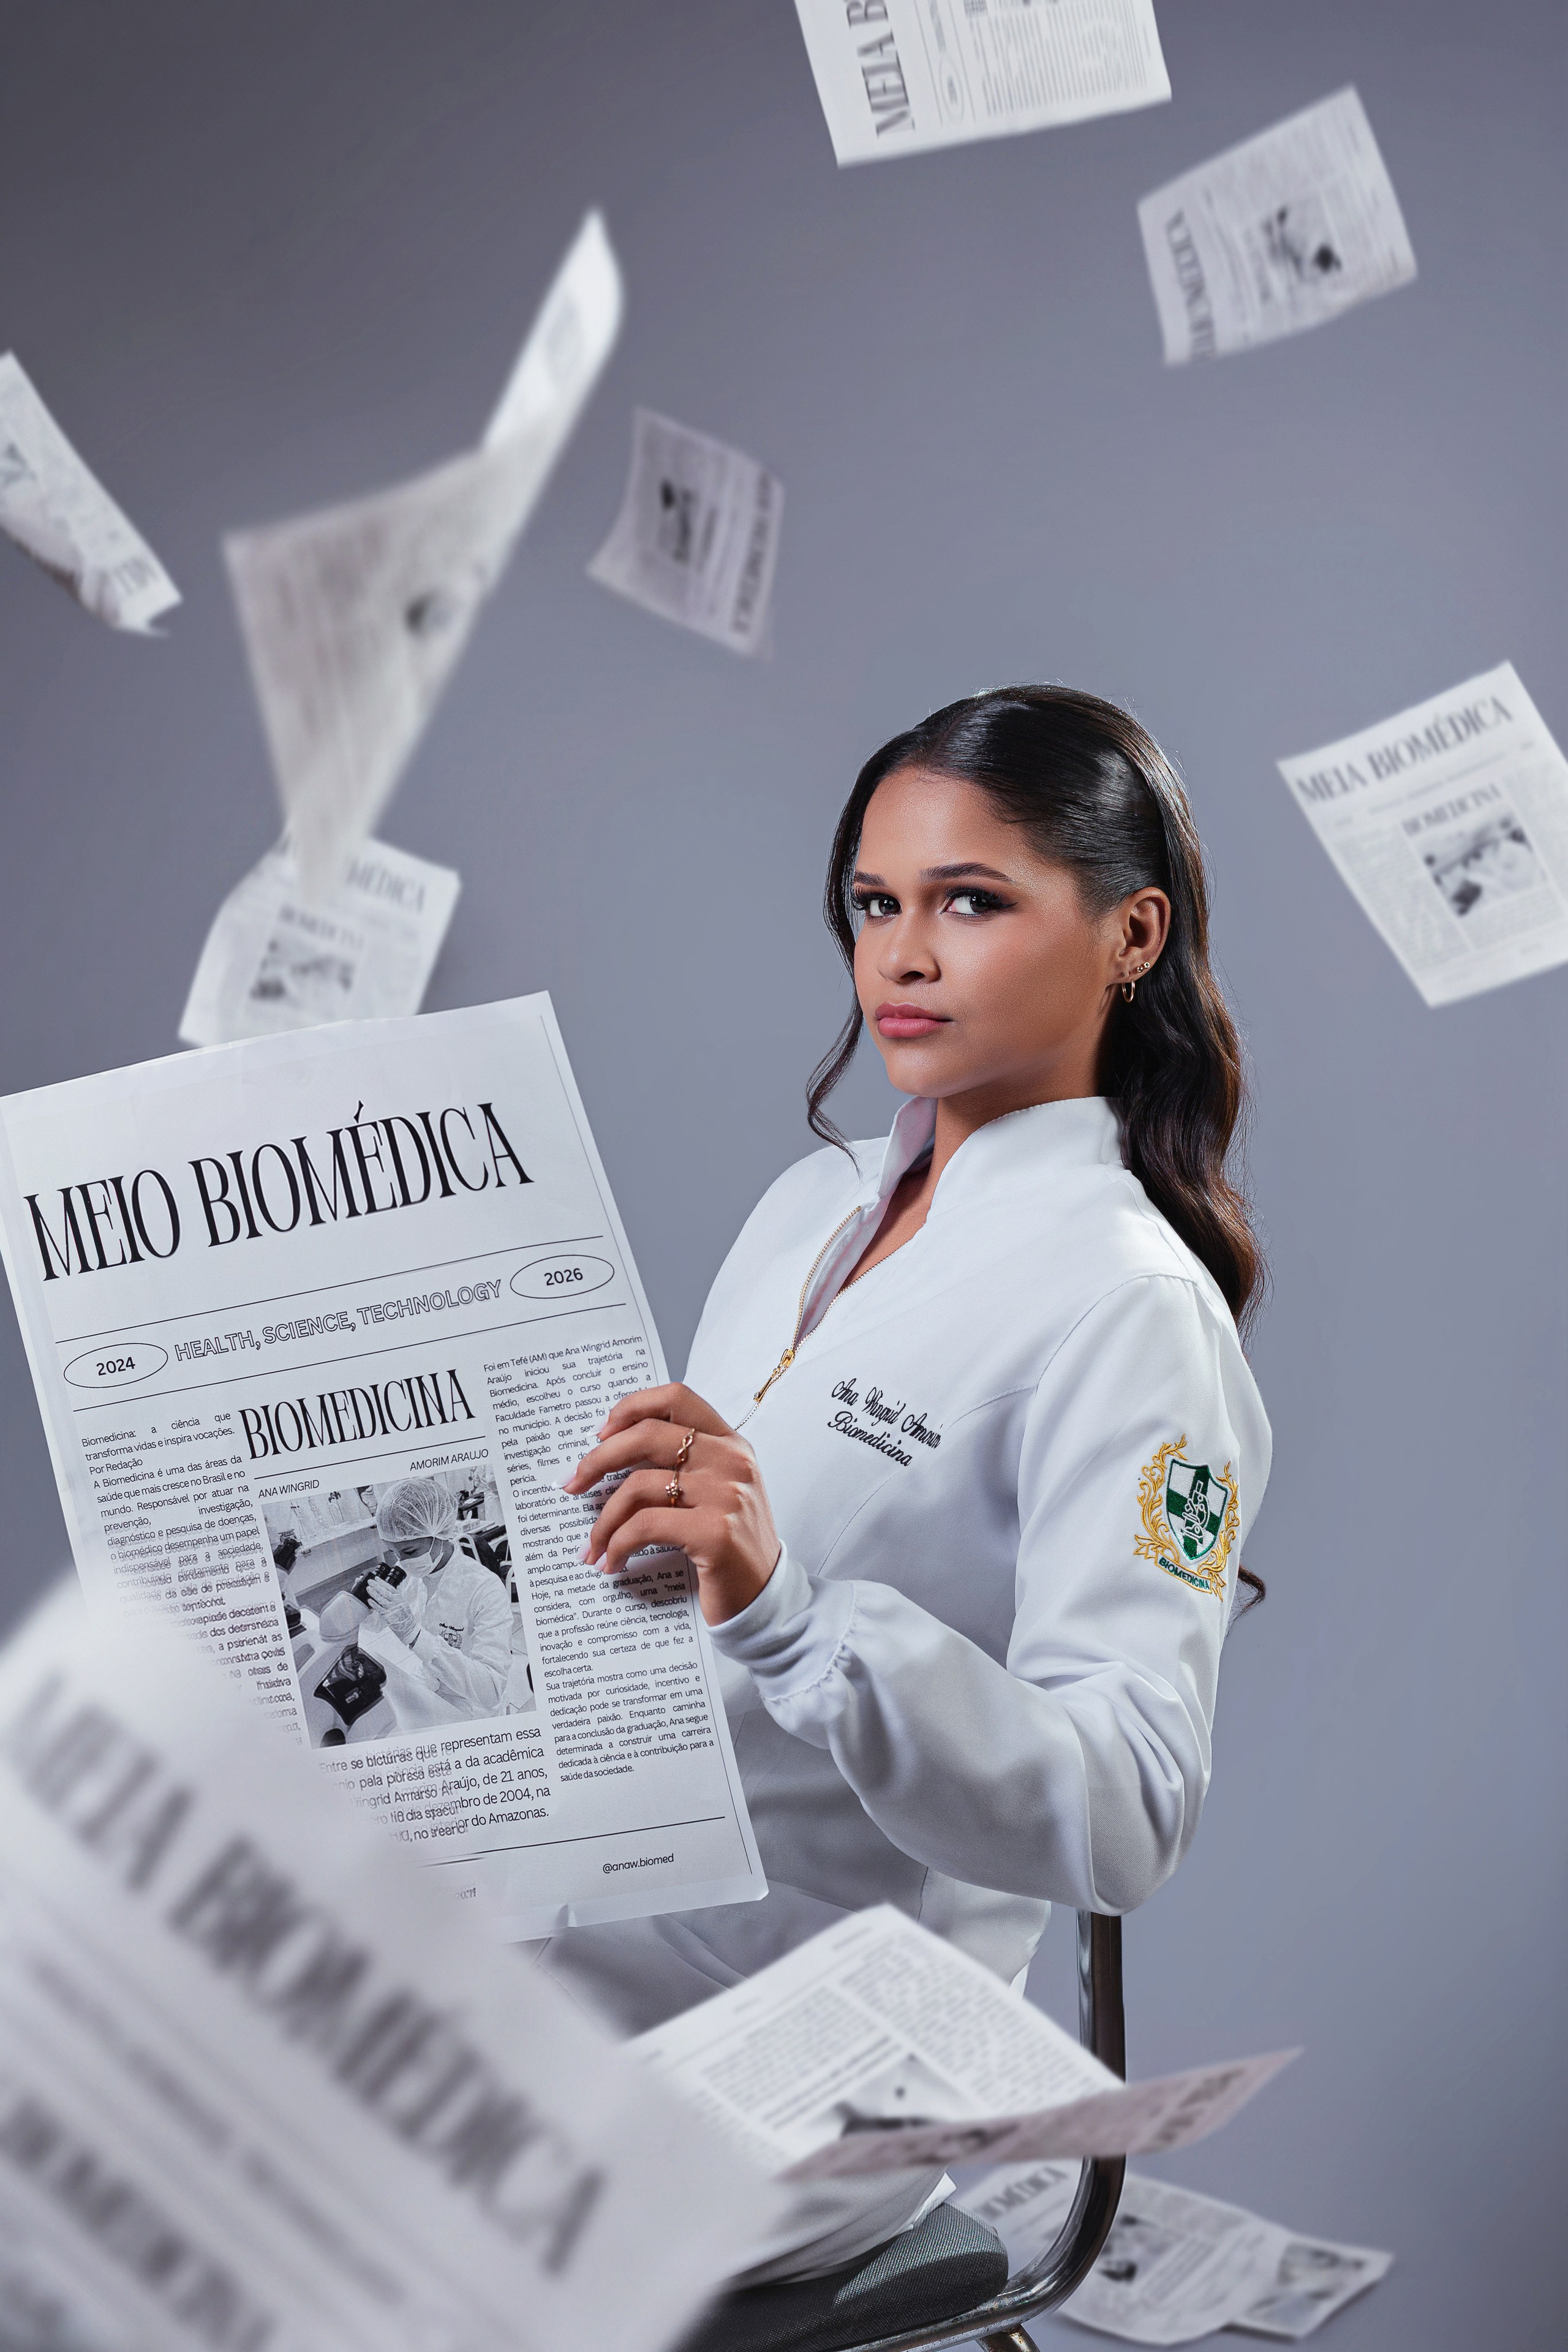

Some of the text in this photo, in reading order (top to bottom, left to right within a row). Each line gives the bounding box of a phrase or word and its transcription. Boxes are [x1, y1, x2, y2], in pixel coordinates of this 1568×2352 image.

[23, 1100, 535, 1282] MEIO BIOMÉDICA
[543, 1267, 583, 1286] 2026
[174, 1278, 501, 1361] HEALTH, SCIENCE, TECHNOLOGY
[96, 1356, 136, 1376] 2024
[483, 1335, 643, 1372] Foi em Tefé (AM) que Ana Wingrid Amorim
[486, 1373, 512, 1385] Araújo
[524, 1366, 549, 1377] iniciou
[562, 1361, 576, 1370] sua
[587, 1351, 624, 1365] trajetória
[546, 1375, 566, 1387] Após
[572, 1368, 602, 1381] concluir
[622, 1361, 649, 1372] ensino
[492, 1398, 519, 1410] médio,
[526, 1391, 560, 1403] escolheu
[579, 1383, 601, 1393] curso
[607, 1375, 638, 1389] quando
[239, 1368, 476, 1460] BIOMEDICINA
[494, 1408, 535, 1423] Faculdade
[538, 1402, 571, 1414] Fametro
[575, 1396, 601, 1409] passou
[512, 1419, 552, 1433] município.
[554, 1416, 561, 1425] A
[564, 1411, 593, 1423] decisão
[595, 1407, 606, 1417] foi
[81, 1430, 137, 1447] Biomedicina:
[171, 1417, 201, 1430] ciência
[214, 1412, 231, 1423] que
[85, 1446, 134, 1461] transforma
[133, 1441, 157, 1451] vidas
[164, 1434, 193, 1446] inspira
[192, 1427, 235, 1441] vocações.
[827, 1411, 913, 1467] Biomedicina
[89, 1458, 143, 1475] Por Redação
[94, 1455, 243, 1489] A Biomedicina é uma das áreas da
[258, 1448, 489, 1499] ANA WINGRID AMORIM ARAUJO
[96, 1491, 123, 1503] saúde
[123, 1489, 140, 1500] que
[141, 1483, 162, 1495] mais
[162, 1480, 189, 1491] cresce
[190, 1478, 202, 1487] no
[202, 1472, 227, 1484] Brasil
[233, 1470, 246, 1479] no
[100, 1504, 134, 1517] mundo.
[137, 1493, 190, 1510] Responsável
[192, 1492, 207, 1503] por
[211, 1487, 233, 1498] atuar
[104, 1498, 253, 1534] prevenção, investigação,
[107, 1531, 156, 1546] diagnóstico
[165, 1522, 203, 1538] pesquisa
[204, 1519, 216, 1529] de
[217, 1513, 257, 1526] doenças,
[117, 1544, 163, 1558] biomédico
[164, 1534, 219, 1553] desempenha
[219, 1532, 235, 1541] um
[235, 1525, 260, 1540] papel
[1158, 1556, 1210, 1590] BIOMEDICINA
[543, 1664, 594, 1678] escolha certa.
[545, 1660, 698, 1691] Sua trajetória mostra como uma decisão
[548, 1691, 582, 1704] motivada
[587, 1690, 600, 1700] por
[605, 1681, 650, 1695] curiosidade,
[654, 1676, 690, 1687] incentivo
[549, 1704, 587, 1717] dedicação
[589, 1700, 609, 1713] pode
[622, 1693, 667, 1706] transformar
[684, 1688, 703, 1697] uma
[551, 1700, 706, 1730] verdadeira paixão. Enquanto caminha
[554, 1734, 571, 1745] para
[577, 1727, 615, 1740] conclusão
[615, 1725, 626, 1734] da
[626, 1719, 668, 1735] graduação,
[669, 1717, 685, 1726] Ana
[685, 1714, 709, 1724] segue
[440, 1728, 541, 1756] representam essa
[556, 1741, 603, 1756] determinada
[618, 1734, 652, 1747] construir
[657, 1732, 677, 1741] uma
[681, 1725, 712, 1738] carreira
[454, 1747, 545, 1770] a da acadêmica
[482, 1772, 498, 1785] de
[500, 1770, 514, 1783] 21
[516, 1767, 548, 1781] anos,
[482, 1787, 551, 1805] de 2004, na
[470, 1807, 549, 1826] do Amazonas.
[602, 1852, 674, 1874] @anaw.biomed
